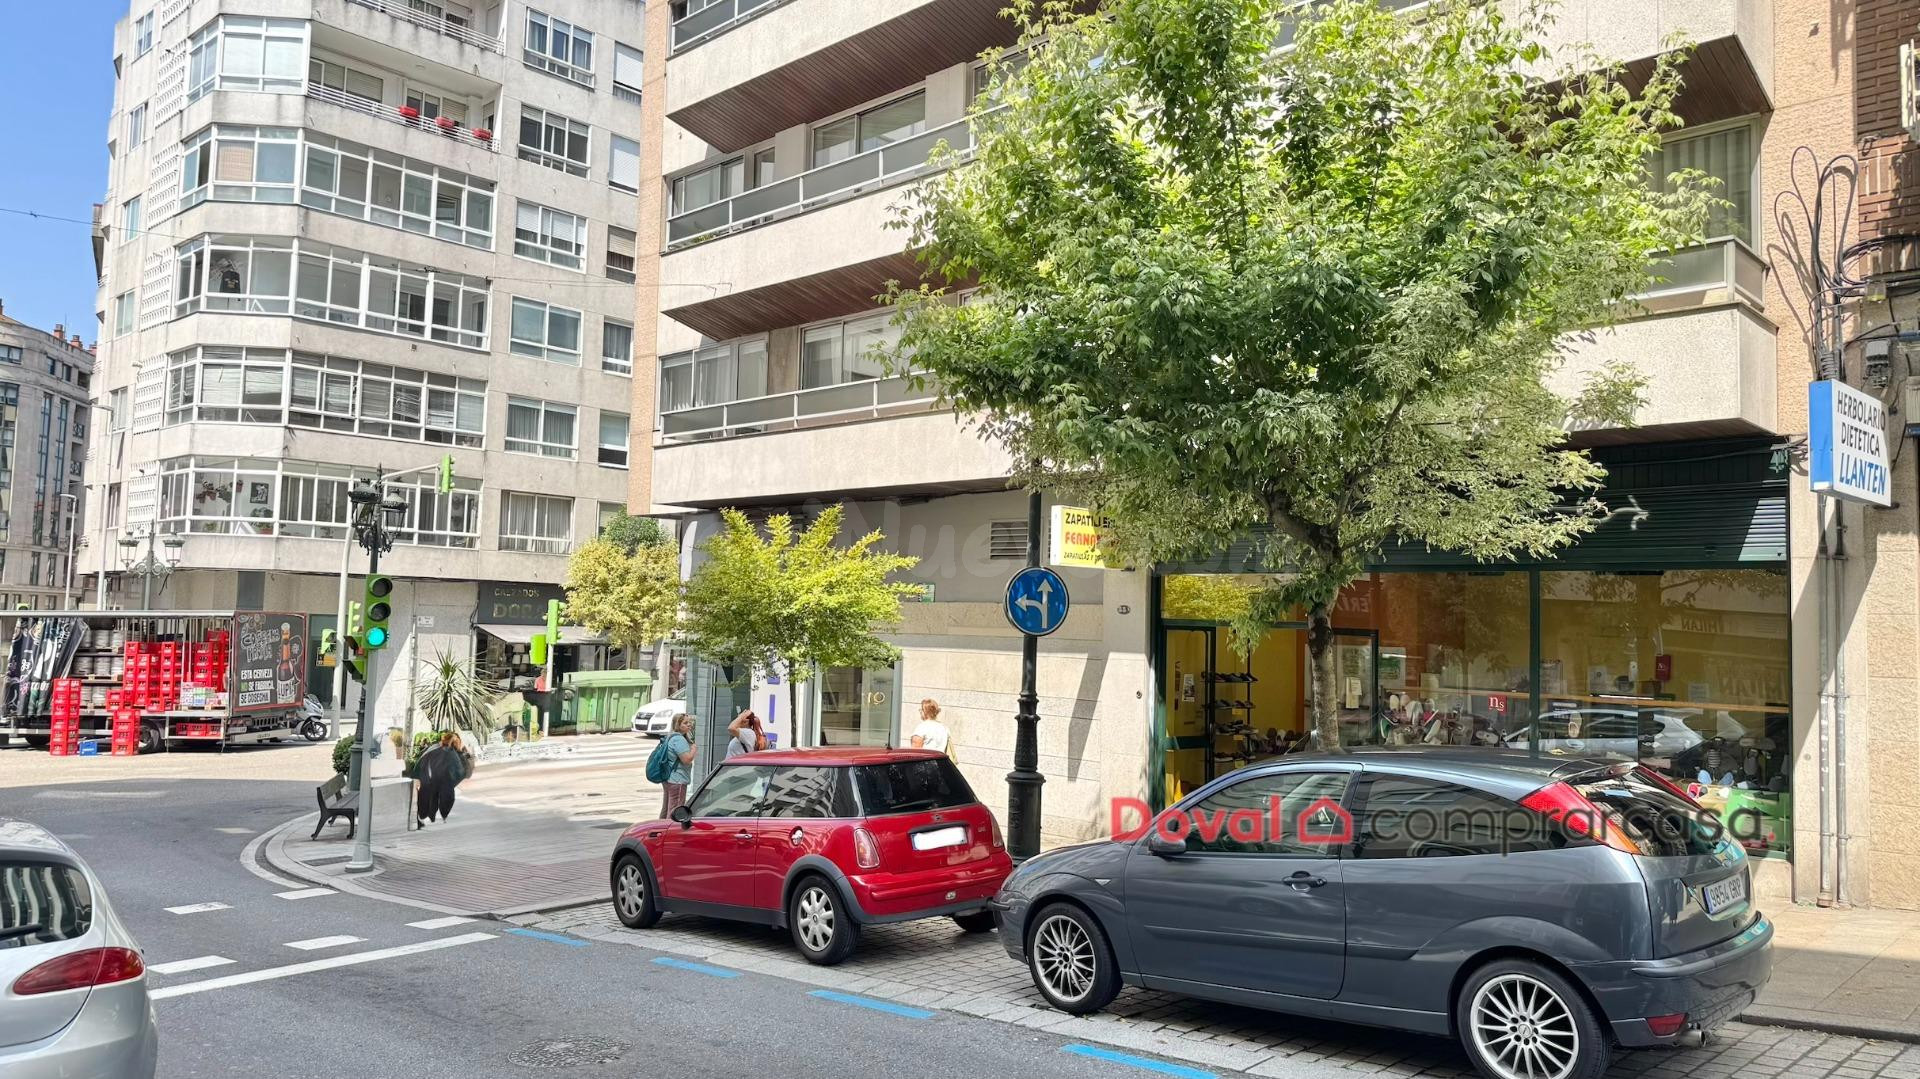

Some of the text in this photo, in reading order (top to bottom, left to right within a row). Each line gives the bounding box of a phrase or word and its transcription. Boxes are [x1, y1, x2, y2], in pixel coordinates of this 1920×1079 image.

[1837, 390, 1886, 431] HERBOLARIO
[1841, 422, 1880, 457] DIETETICA
[1839, 453, 1887, 495] LLANTEN
[1710, 883, 1730, 907] 9854
